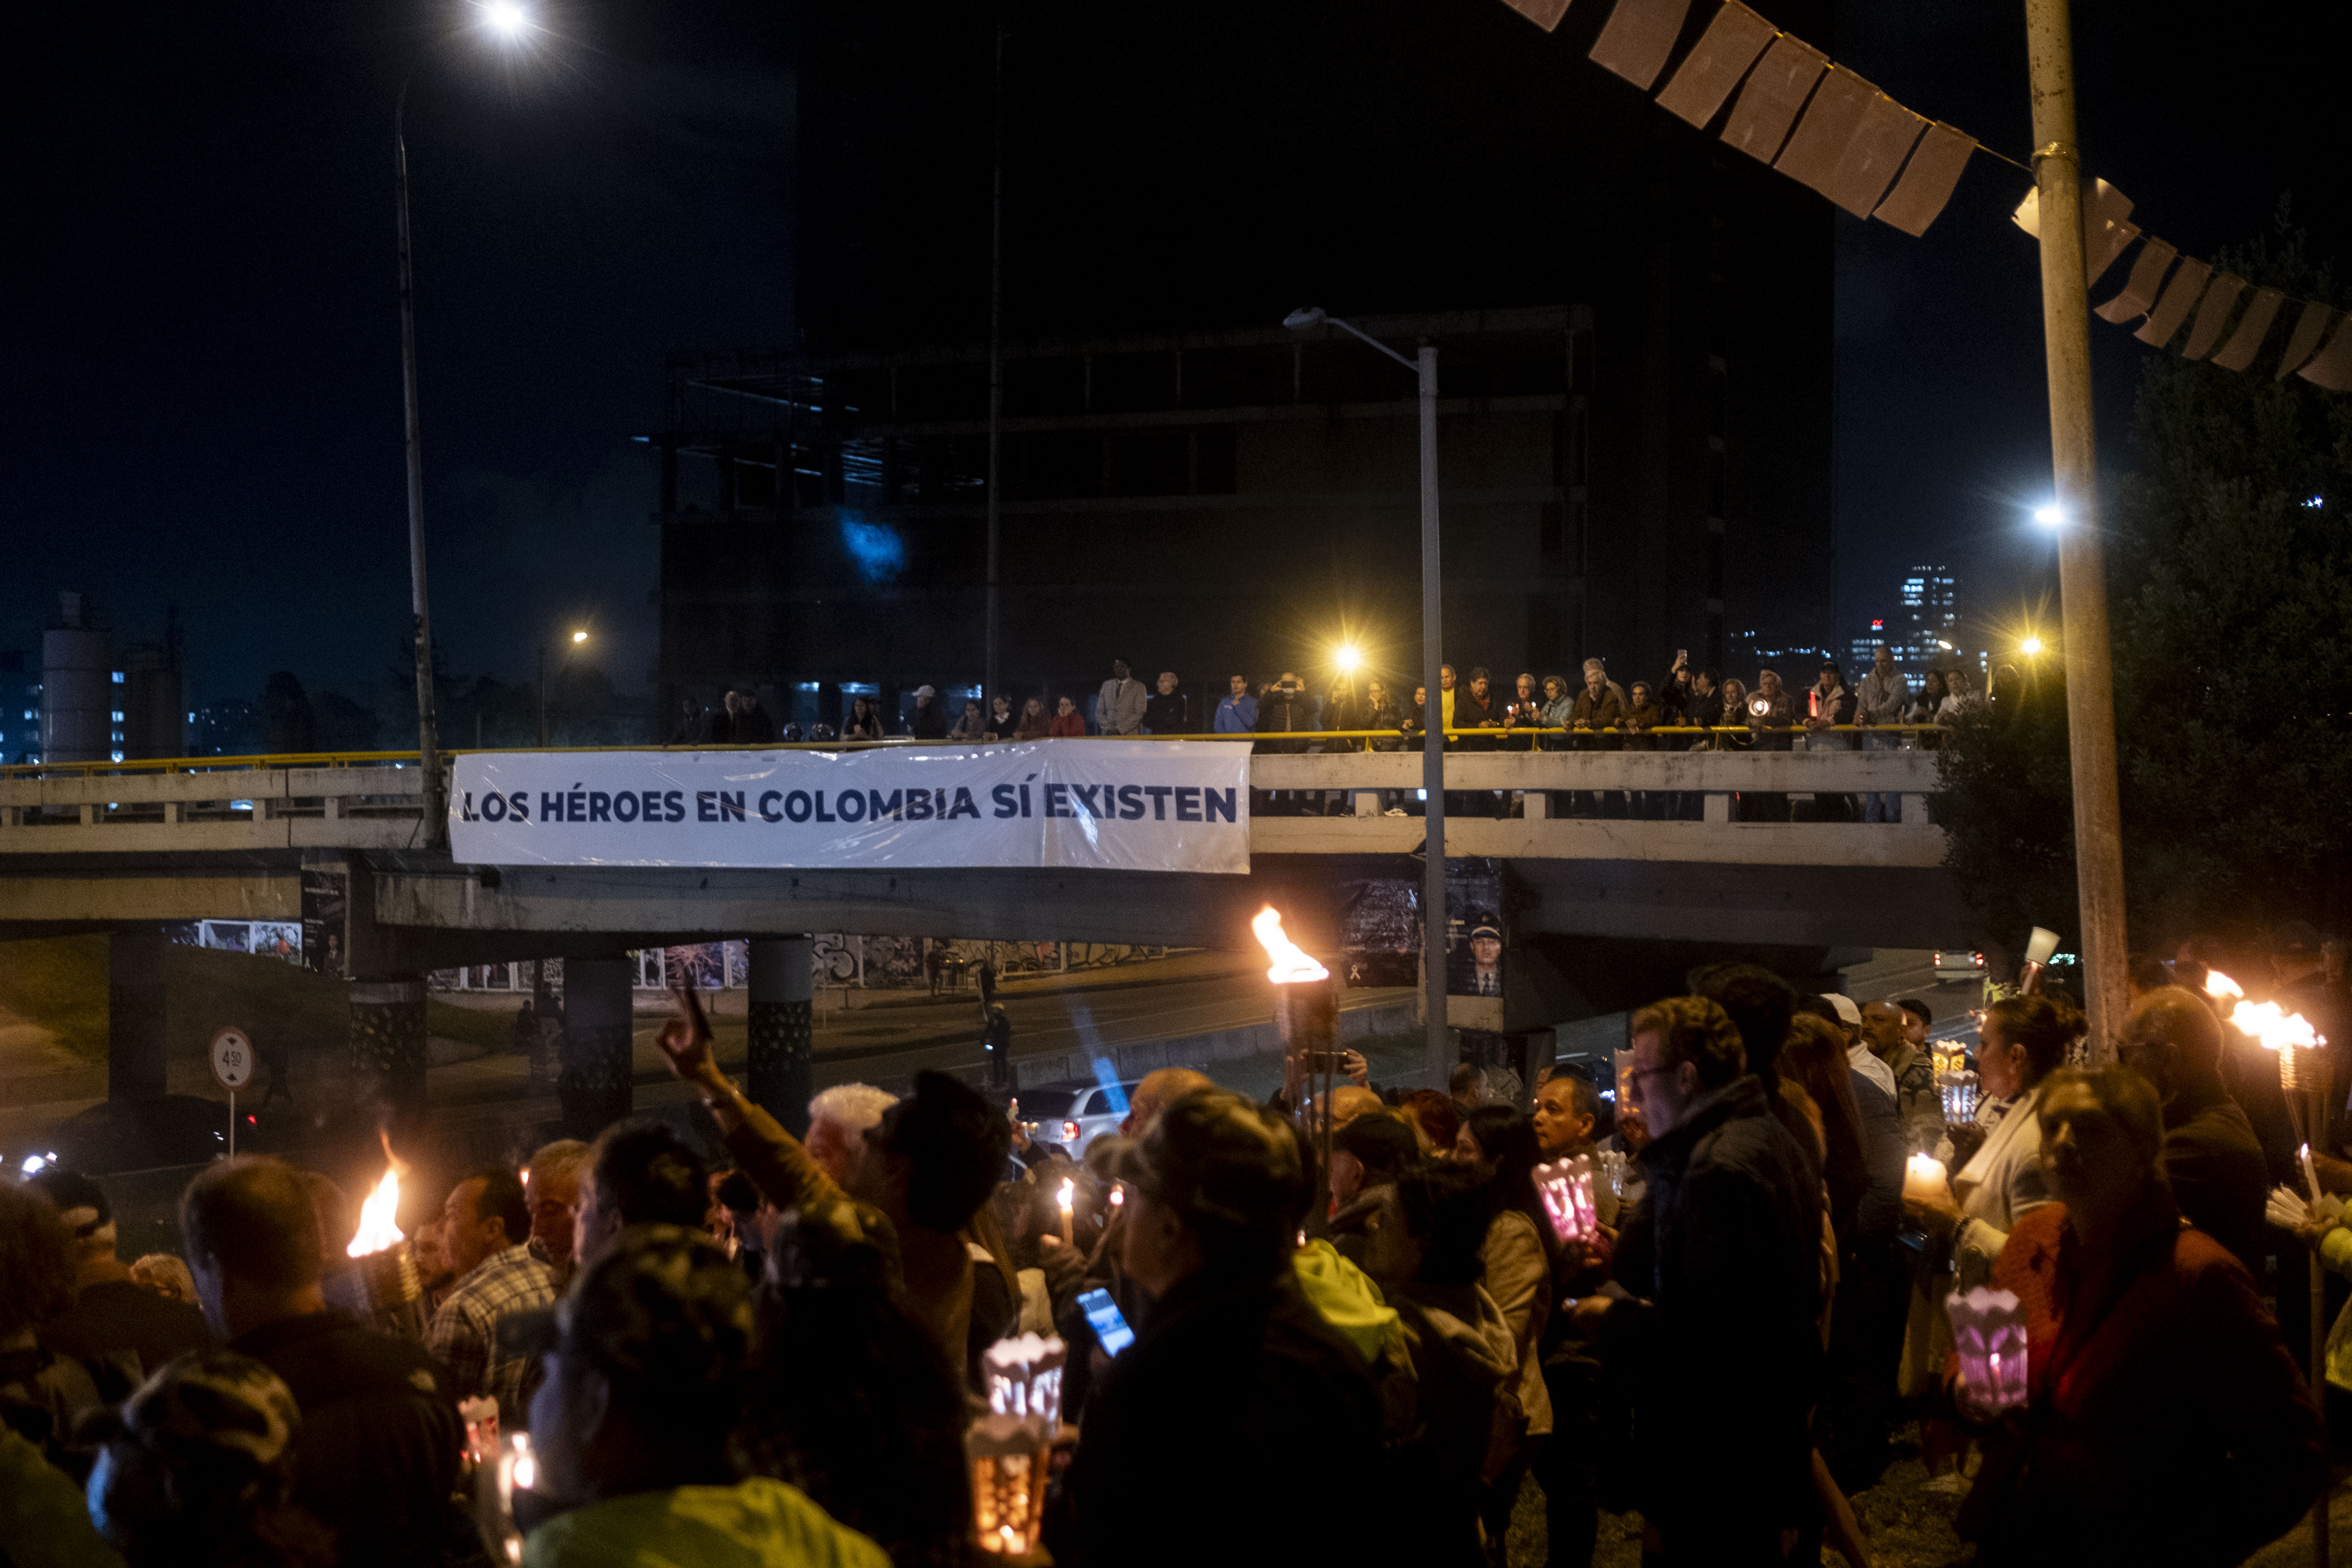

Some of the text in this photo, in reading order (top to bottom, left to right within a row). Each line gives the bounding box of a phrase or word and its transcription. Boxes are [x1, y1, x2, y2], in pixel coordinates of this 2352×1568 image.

[462, 773, 1237, 824] LOS HÉROES EN COLOMBIA SÍ EXISTEN
